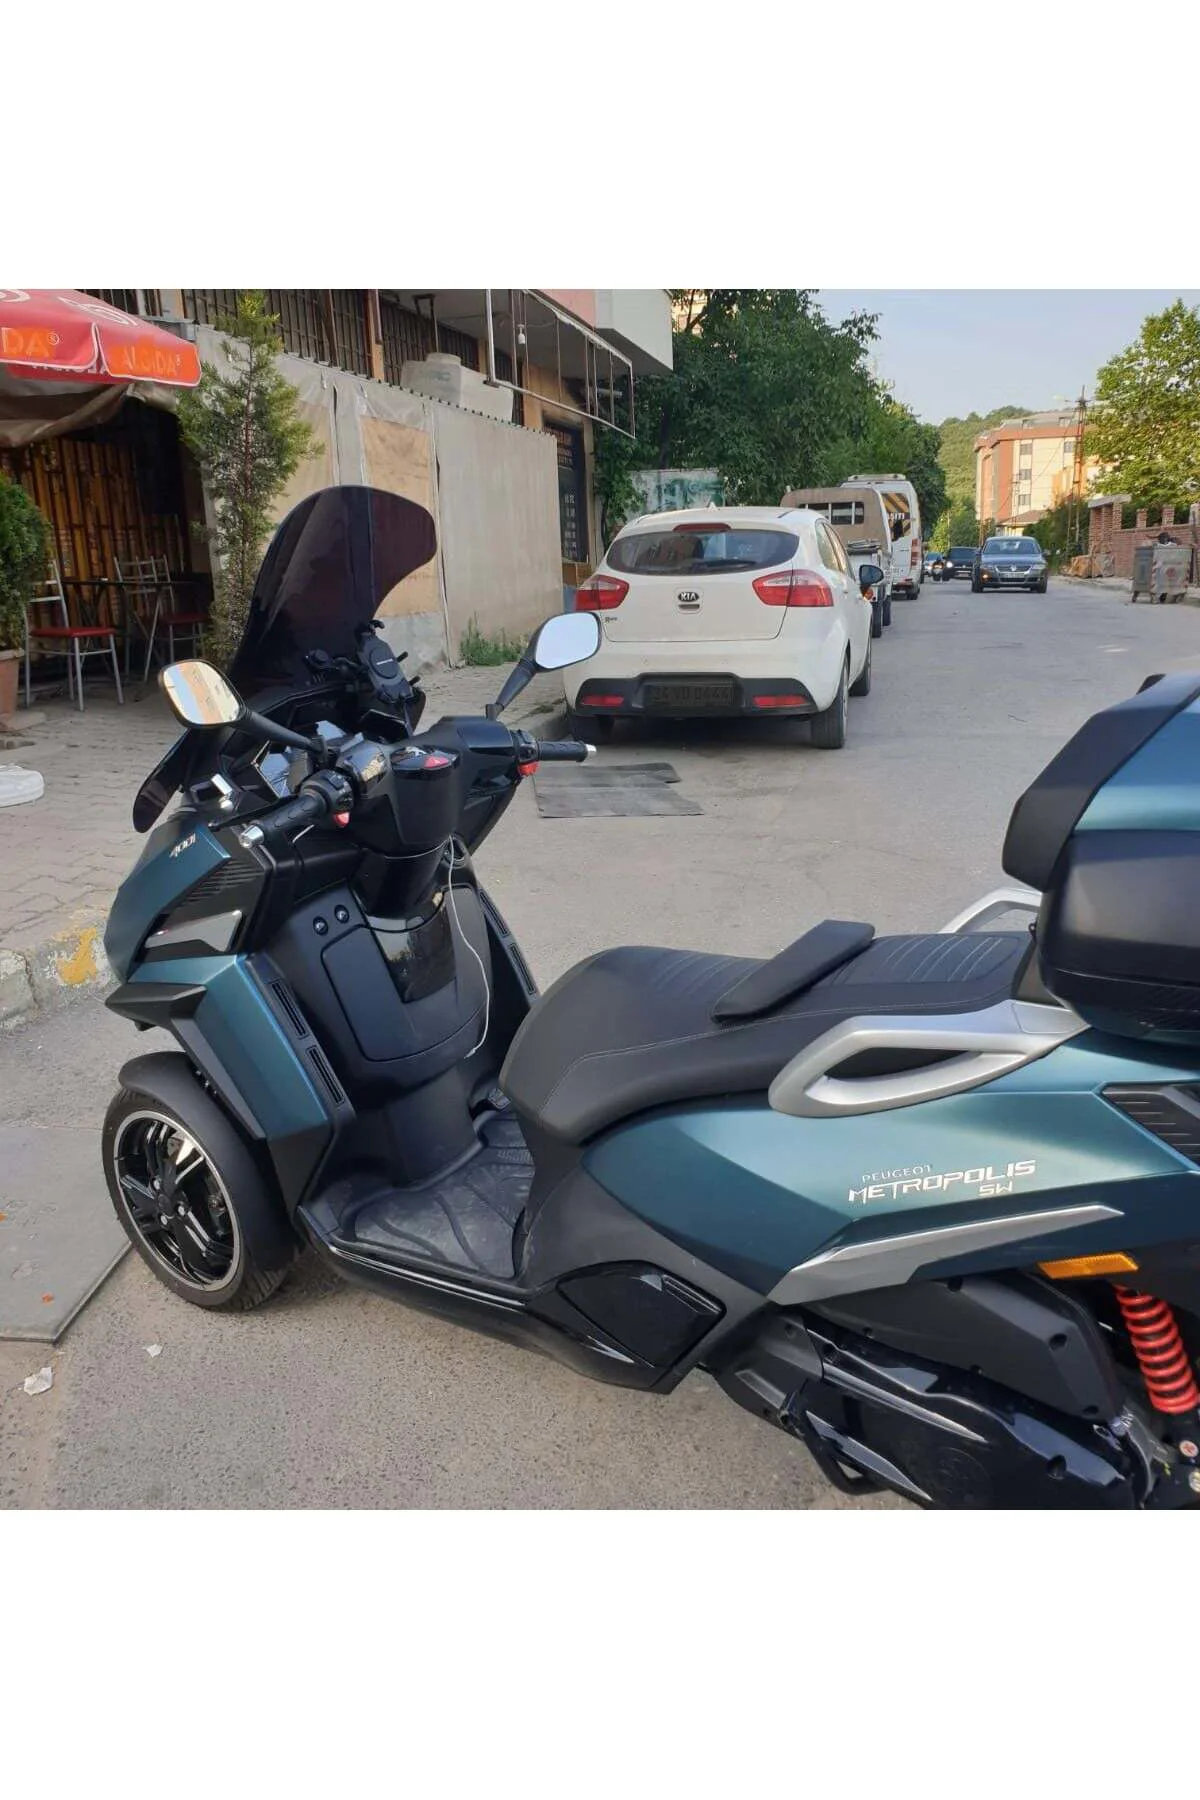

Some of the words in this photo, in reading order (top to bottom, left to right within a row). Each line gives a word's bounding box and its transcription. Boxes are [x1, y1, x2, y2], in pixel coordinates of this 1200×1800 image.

[680, 591, 698, 601] KIA
[848, 1160, 1036, 1204] METROPOLIS
[862, 1164, 932, 1183] PEUGEOT
[978, 1182, 1013, 1197] SW
